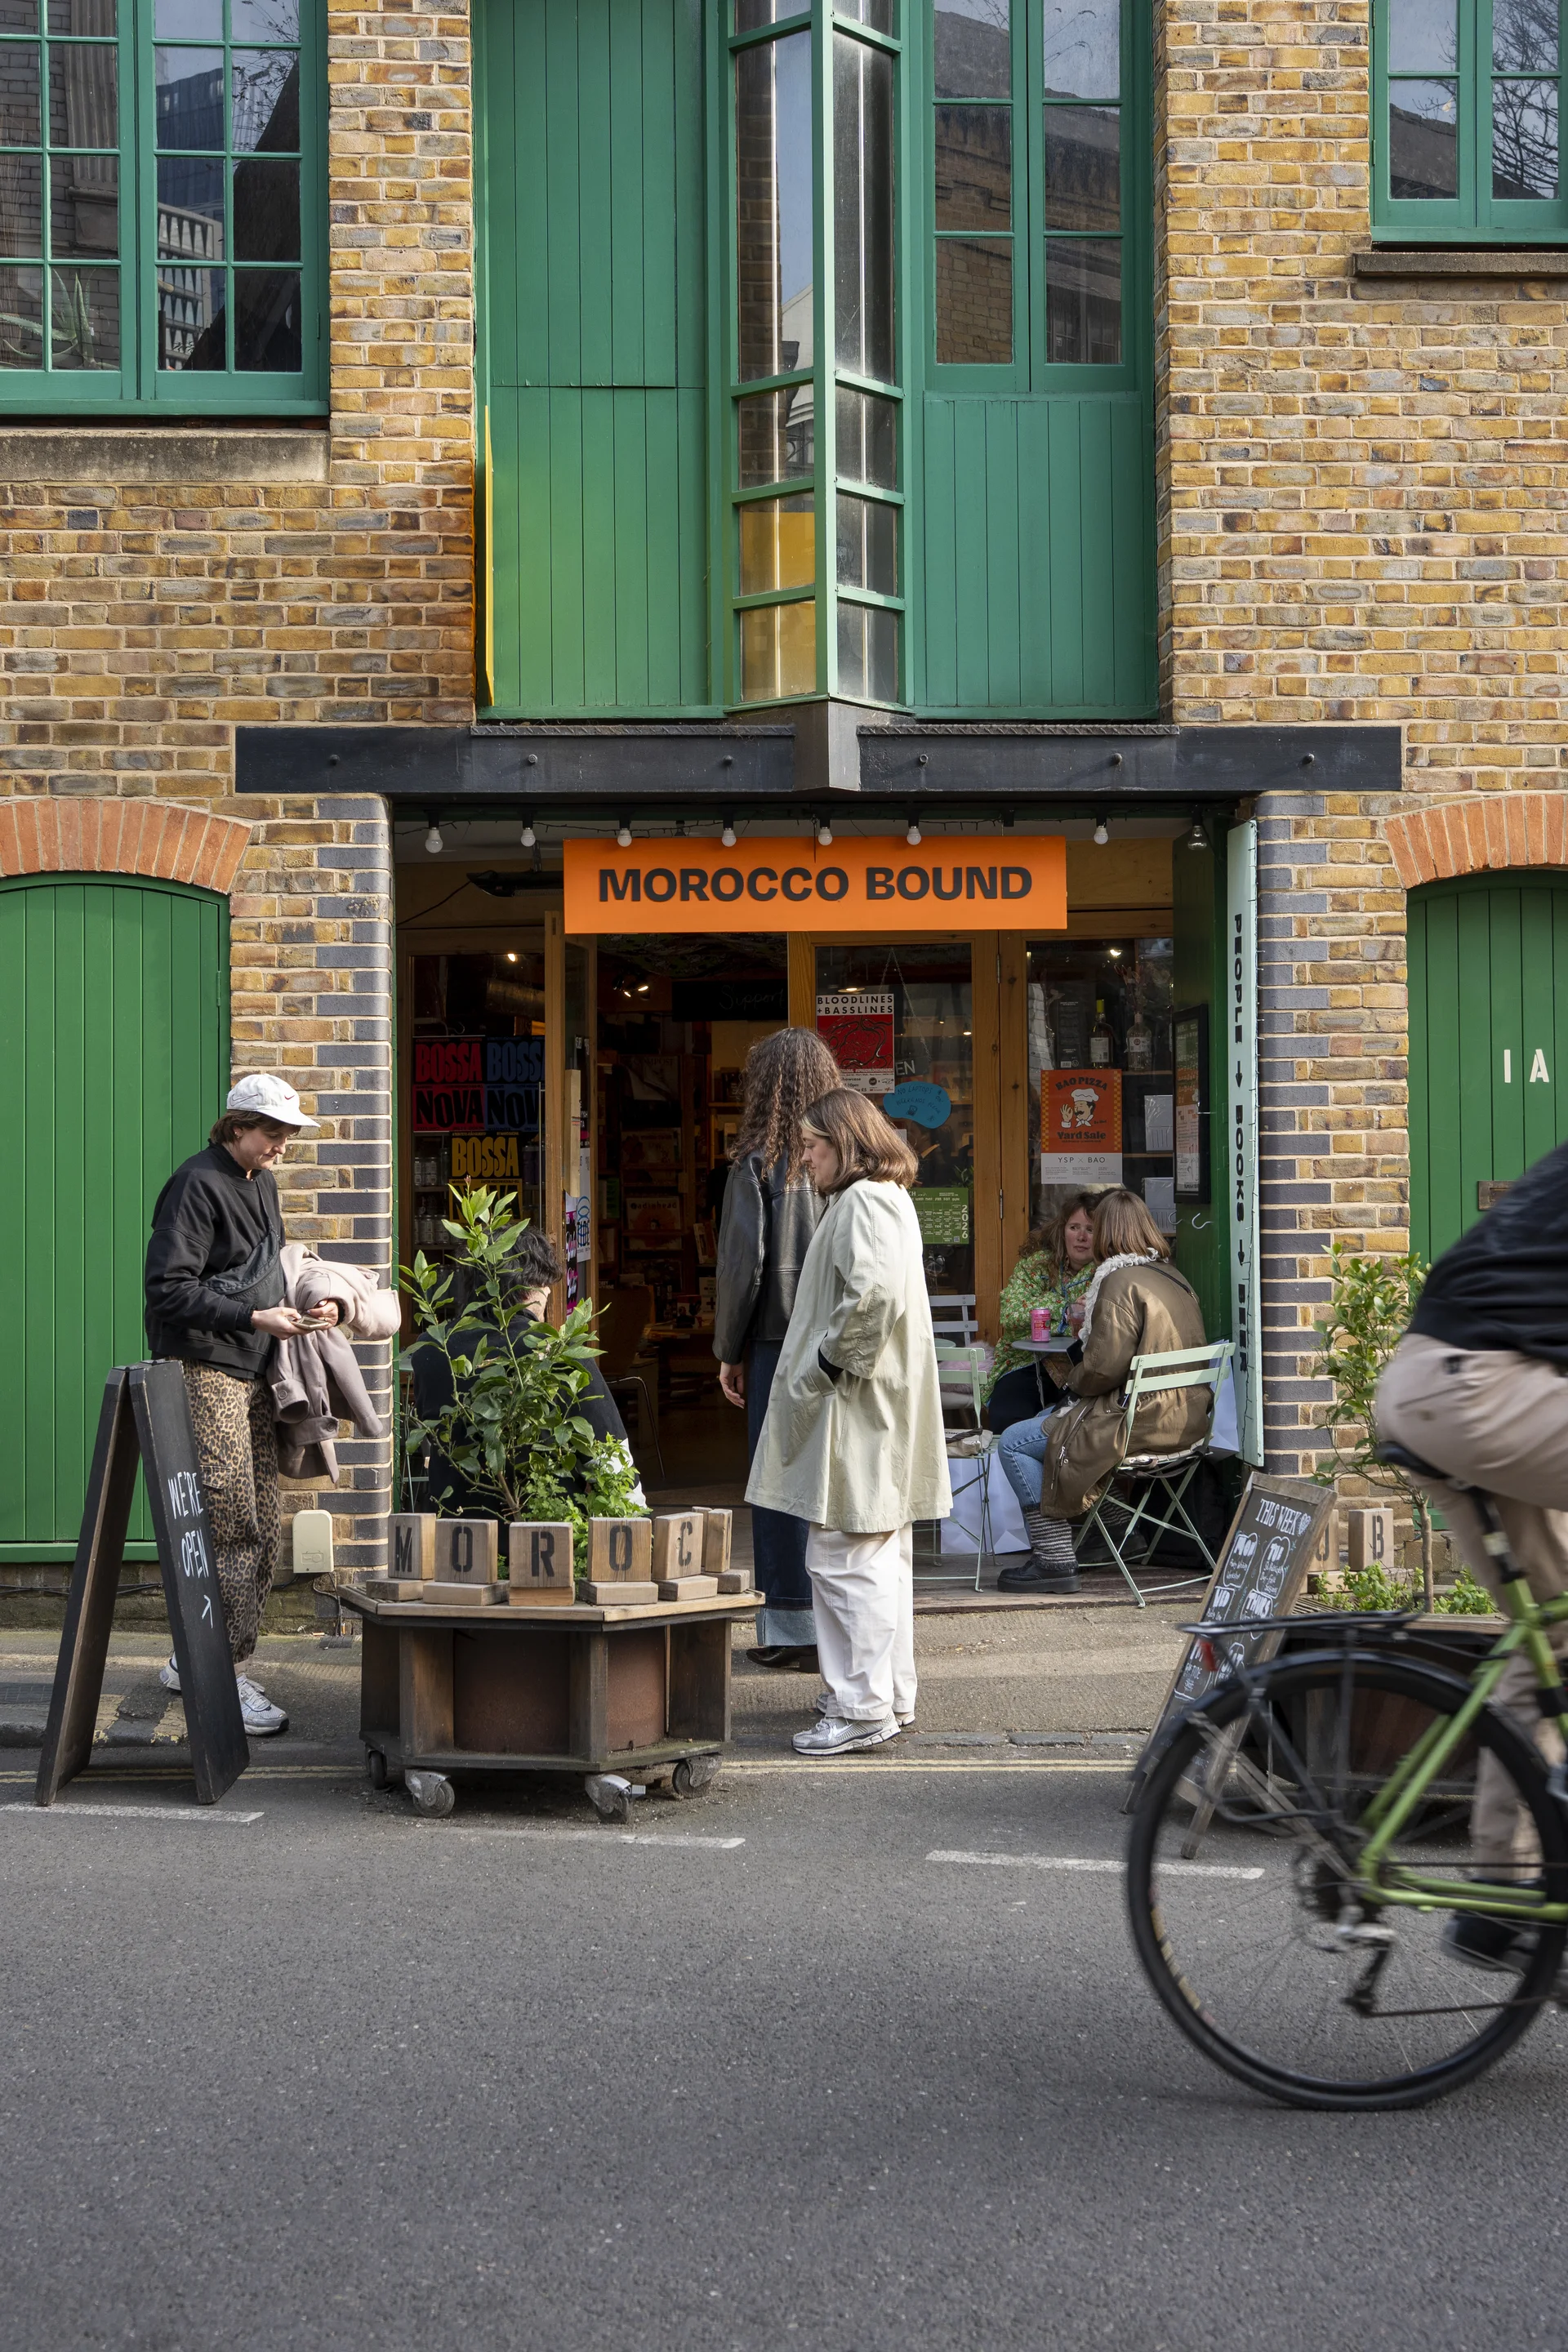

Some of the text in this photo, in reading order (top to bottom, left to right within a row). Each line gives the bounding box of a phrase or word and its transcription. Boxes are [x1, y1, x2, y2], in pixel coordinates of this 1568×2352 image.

[599, 865, 1032, 902] MOROCCO BOUND
[719, 982, 786, 1011] Support
[1234, 913, 1243, 1045] PEOPLE
[817, 994, 893, 1004] BLOODLINES
[817, 1004, 893, 1014] +BASSLINES
[415, 1041, 483, 1083] BOSSA
[487, 1040, 544, 1083] BOSS
[895, 1060, 915, 1076] EN
[898, 1085, 933, 1095] NO LAPTOPS
[1055, 1076, 1108, 1091] BAO PIZZA
[416, 1089, 484, 1129] NOVA
[488, 1089, 545, 1128] NOV
[1057, 1131, 1107, 1139] Yard Sale
[452, 1136, 520, 1178] BOSSA
[1235, 1104, 1245, 1223] BOOKS
[167, 1471, 203, 1520] WE'RE
[1255, 1498, 1303, 1535] THIS WEEK
[181, 1526, 210, 1579] OPEN
